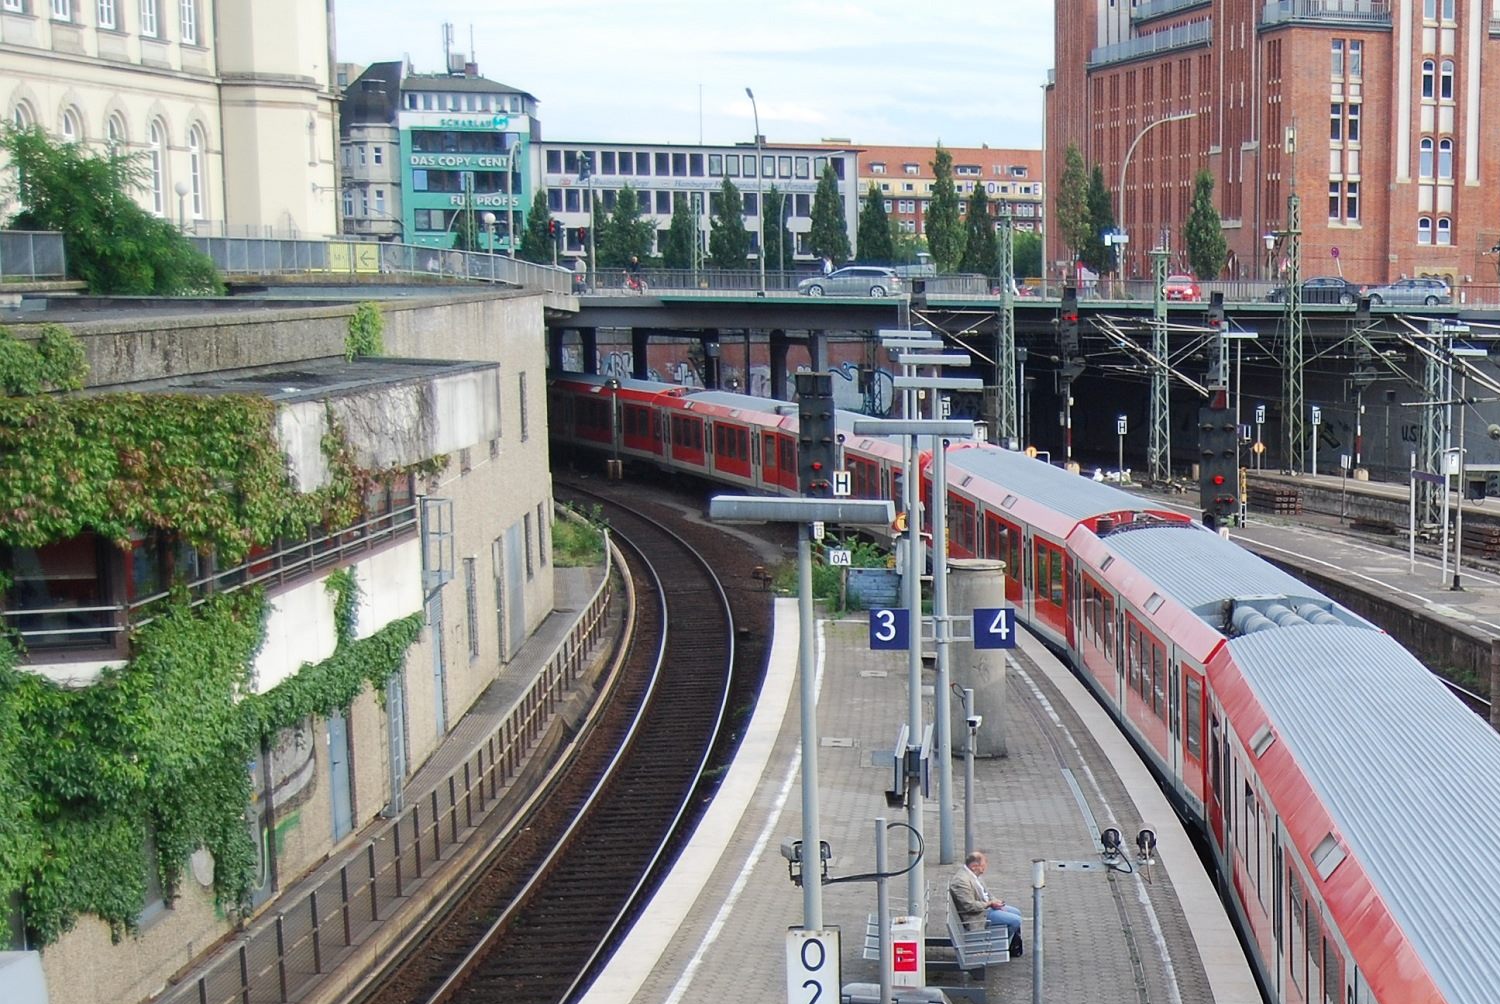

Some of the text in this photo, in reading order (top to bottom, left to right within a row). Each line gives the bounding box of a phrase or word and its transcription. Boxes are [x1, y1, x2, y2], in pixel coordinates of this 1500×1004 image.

[410, 155, 435, 167] DAS
[477, 195, 519, 207] PROFS
[836, 473, 848, 493] H
[832, 551, 849, 564] öA
[875, 609, 896, 641] 3
[989, 609, 1010, 640] 4
[800, 938, 825, 972] 0
